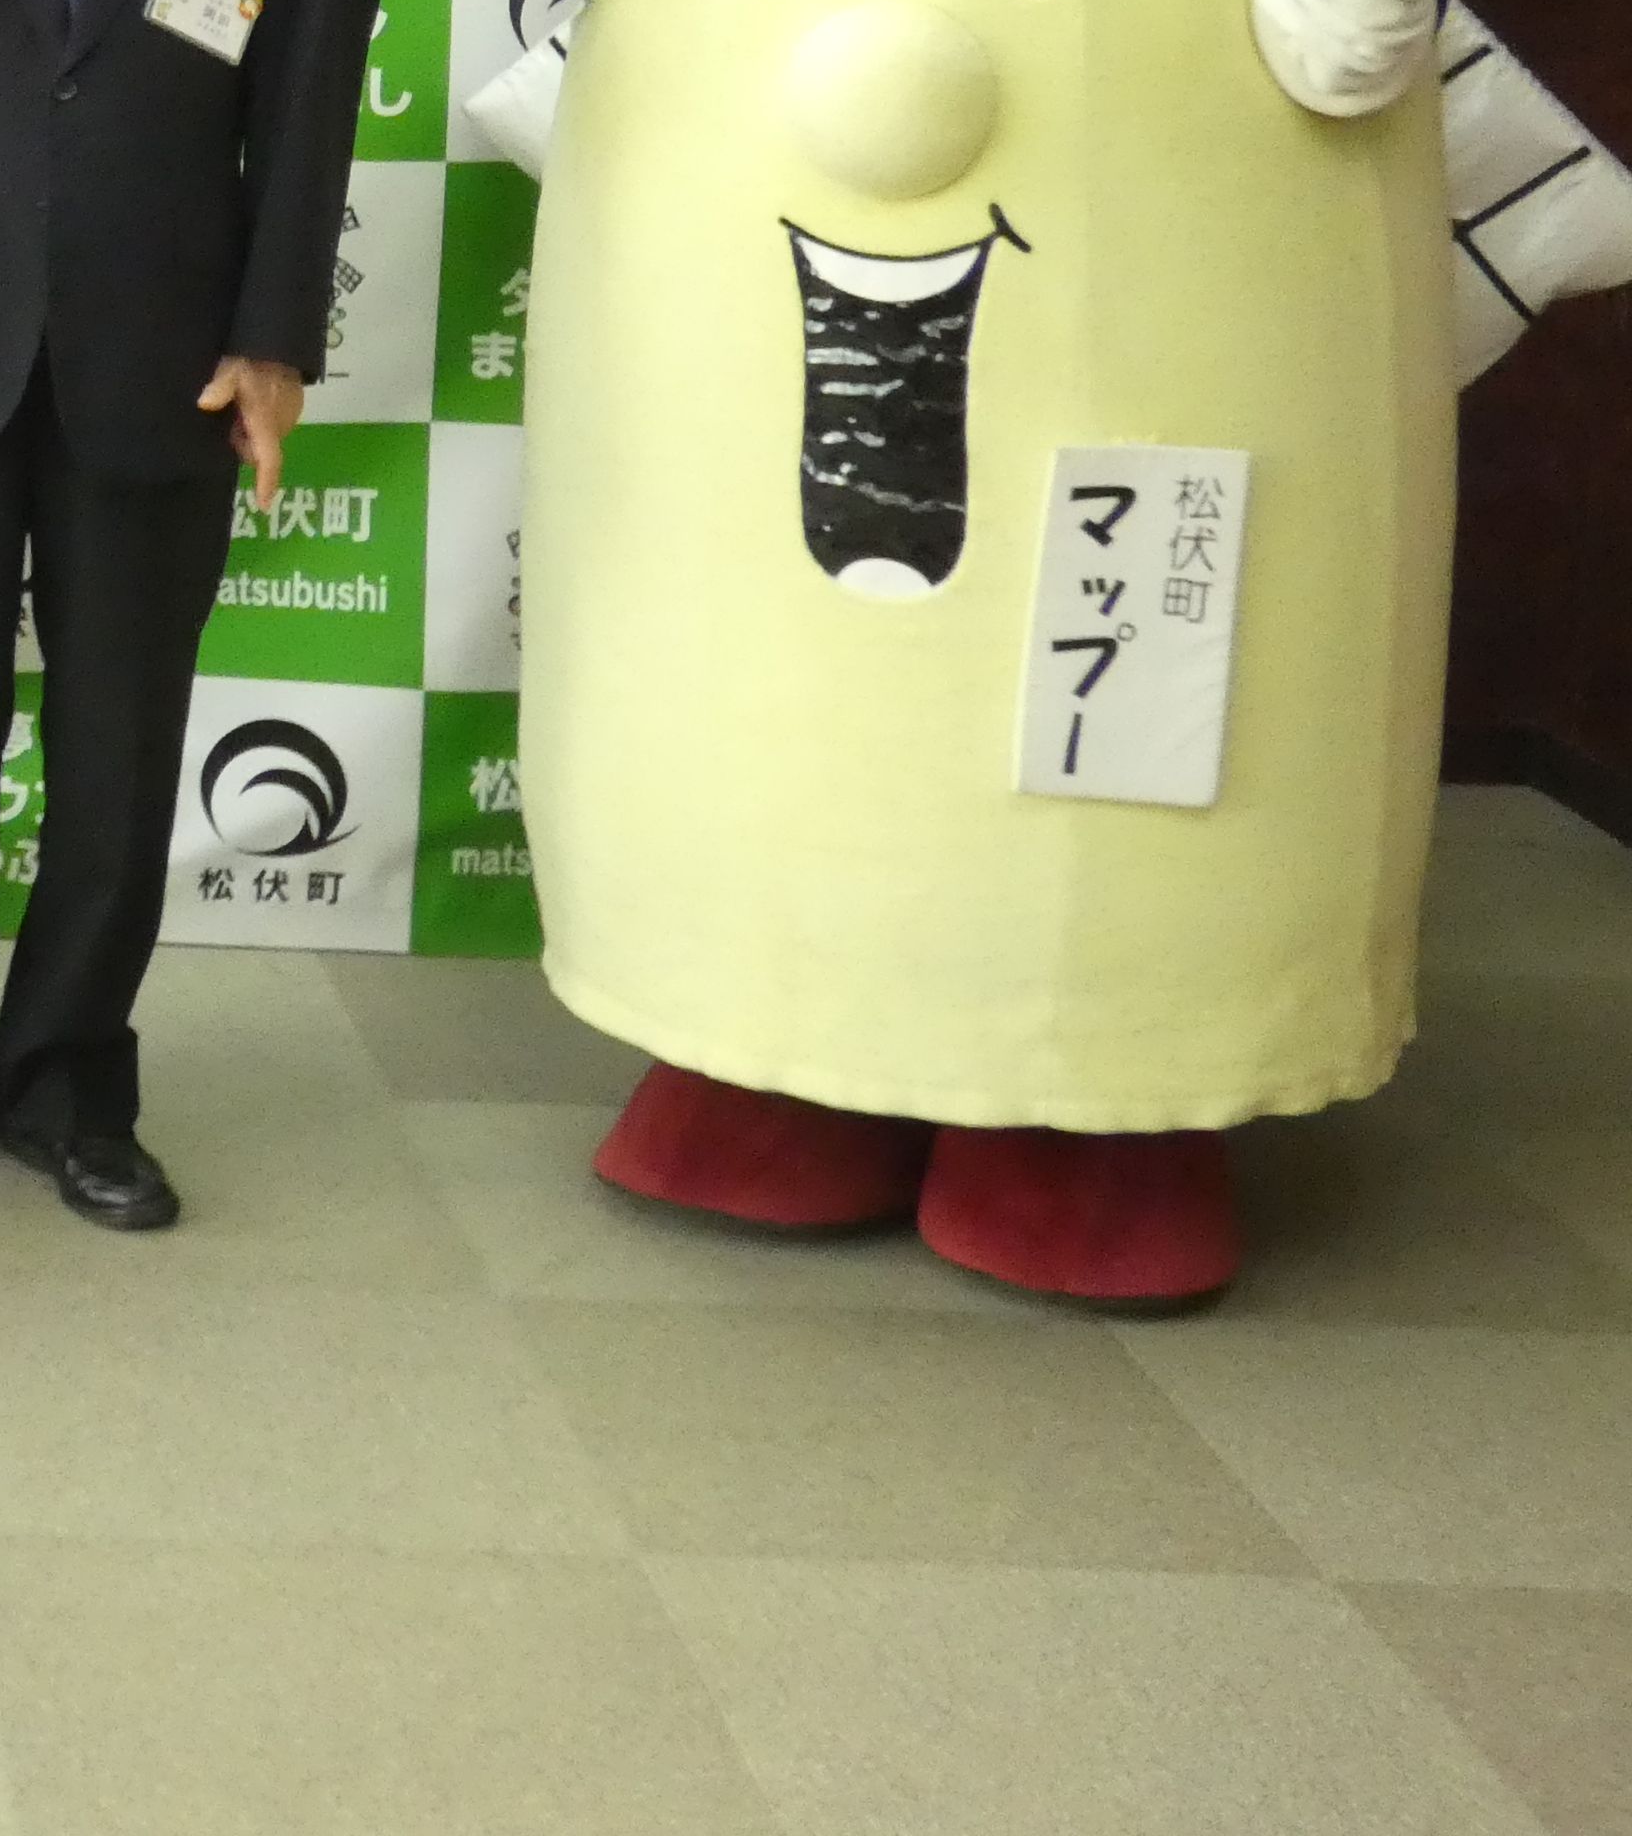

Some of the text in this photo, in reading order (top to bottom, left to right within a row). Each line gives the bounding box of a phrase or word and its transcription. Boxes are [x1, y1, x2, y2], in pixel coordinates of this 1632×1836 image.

[1161, 473, 1226, 625] 松伏町
[1052, 484, 1137, 776] マップー
[198, 868, 345, 906] 松伏町
